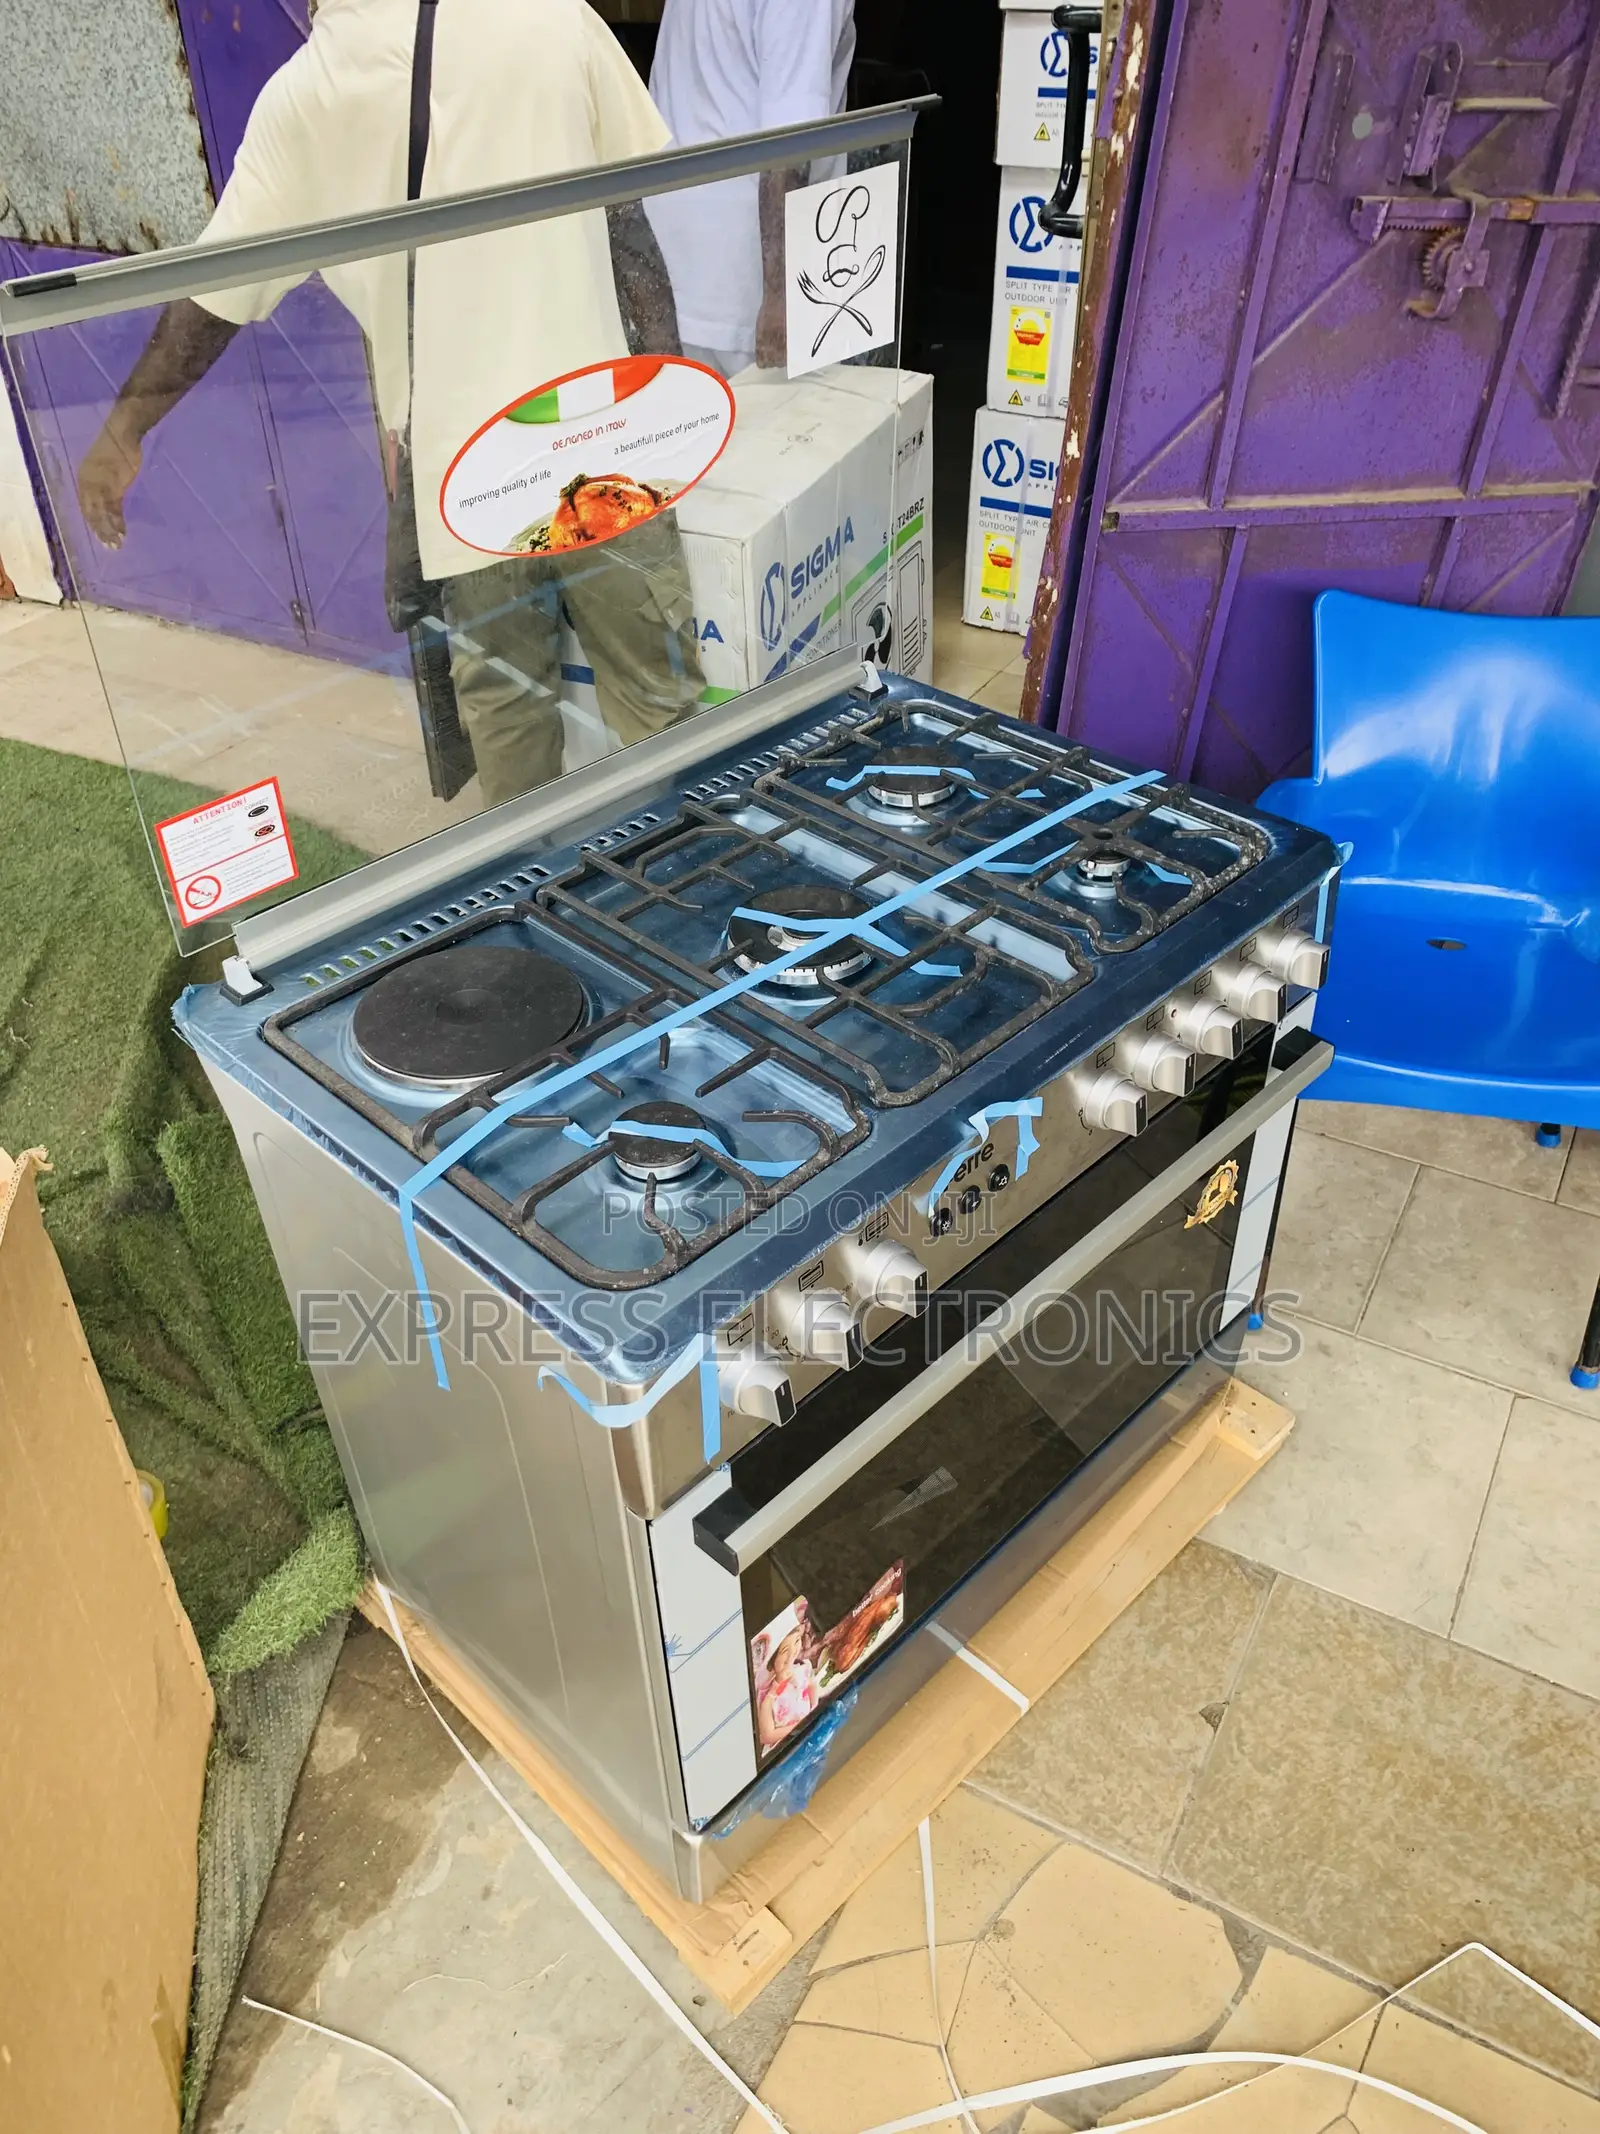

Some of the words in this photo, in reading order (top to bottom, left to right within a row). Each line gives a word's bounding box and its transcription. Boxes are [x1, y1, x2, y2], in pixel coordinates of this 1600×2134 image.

[1004, 292, 1045, 303] OUTDOOR
[1005, 280, 1028, 290] SPLIT
[1032, 283, 1053, 293] TYPE
[552, 429, 594, 451] DESIGNED
[620, 433, 654, 453] beautifull
[655, 428, 674, 443] piece
[675, 424, 683, 434] of
[684, 419, 700, 434] your
[701, 412, 720, 425] home
[1029, 459, 1060, 481] SI
[459, 488, 500, 509] improving
[501, 478, 528, 496] quality
[530, 472, 538, 484] of
[539, 469, 552, 481] life
[978, 520, 1016, 532] OUTDOOR
[979, 510, 1000, 520] SPLIT
[1026, 519, 1039, 528] AIR
[791, 515, 855, 600] SIGMA
[852, 1593, 873, 1618] better
[874, 1567, 902, 1596] cooking
